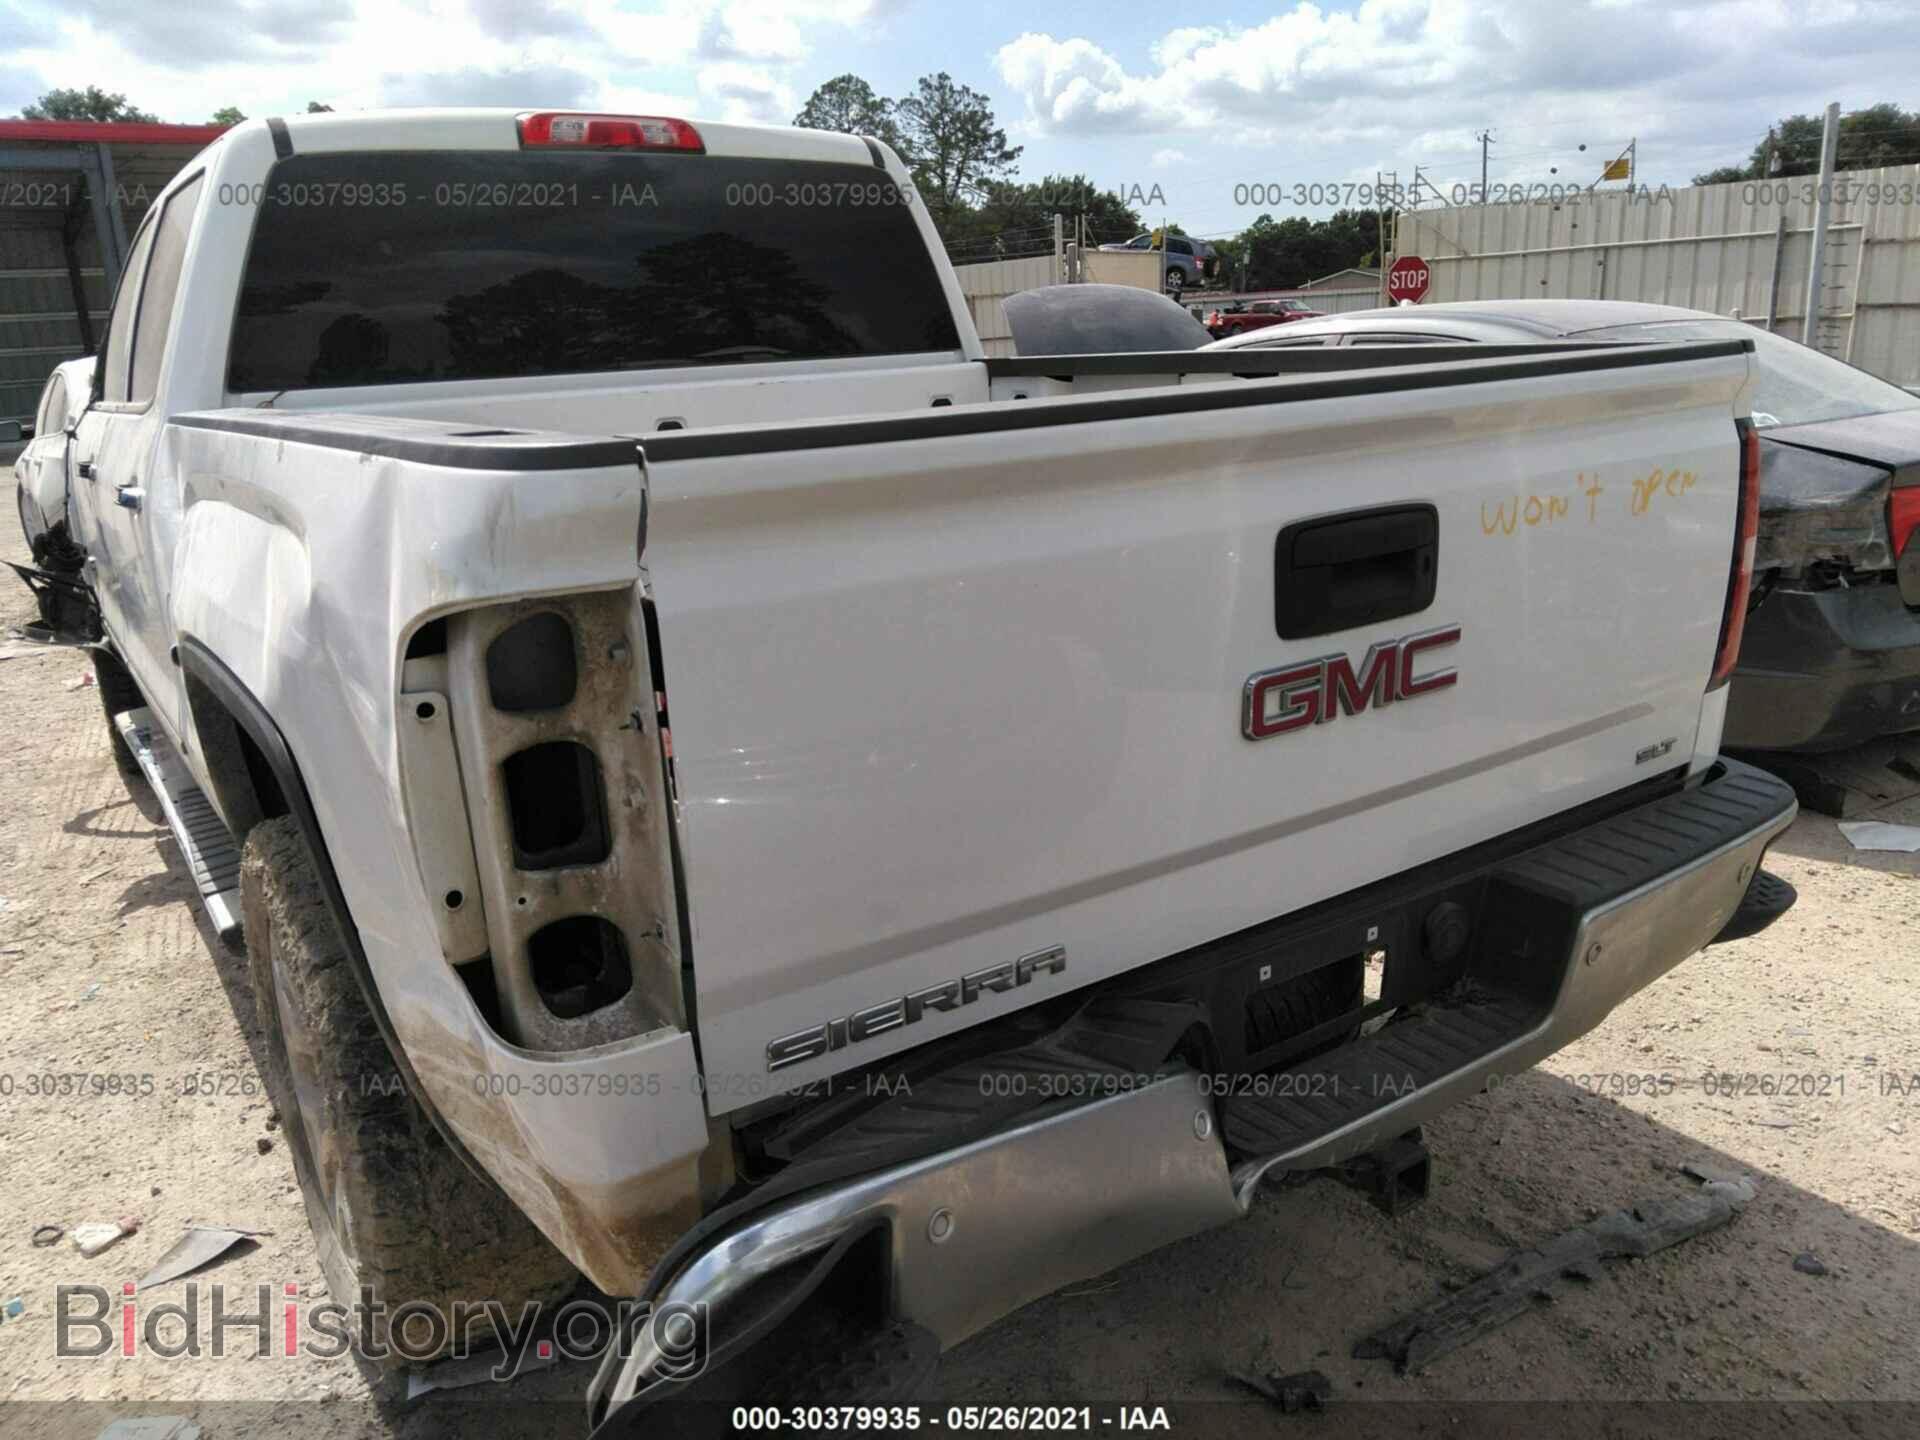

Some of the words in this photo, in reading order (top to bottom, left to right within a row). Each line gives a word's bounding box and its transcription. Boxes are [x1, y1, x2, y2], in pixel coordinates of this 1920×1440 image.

[1390, 270, 1427, 289] STOP
[1241, 622, 1461, 741] GMC
[766, 944, 1066, 1073] SIERRA
